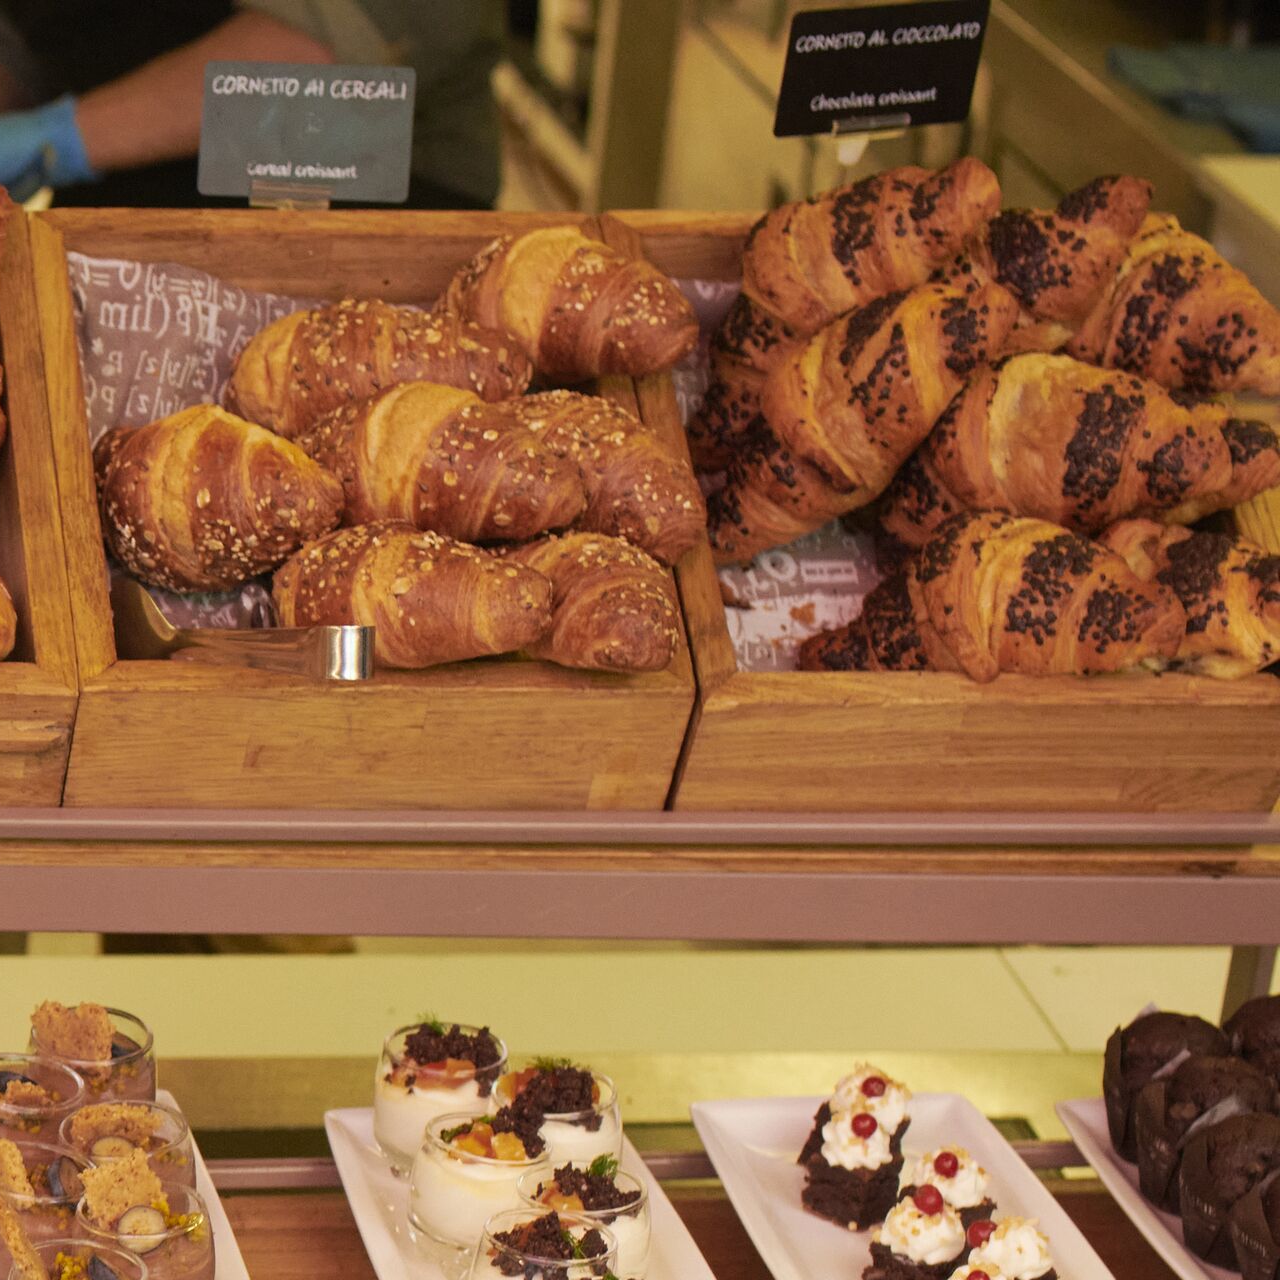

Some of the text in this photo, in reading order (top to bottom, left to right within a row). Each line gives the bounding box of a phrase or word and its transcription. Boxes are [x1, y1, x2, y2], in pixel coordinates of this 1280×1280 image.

[796, 22, 981, 53] CORNETTO AL CIOCCOLATO
[212, 75, 407, 100] CORNETTO AI CEREALI
[810, 87, 937, 111] Chocolate croissant
[295, 163, 357, 178] croissant
